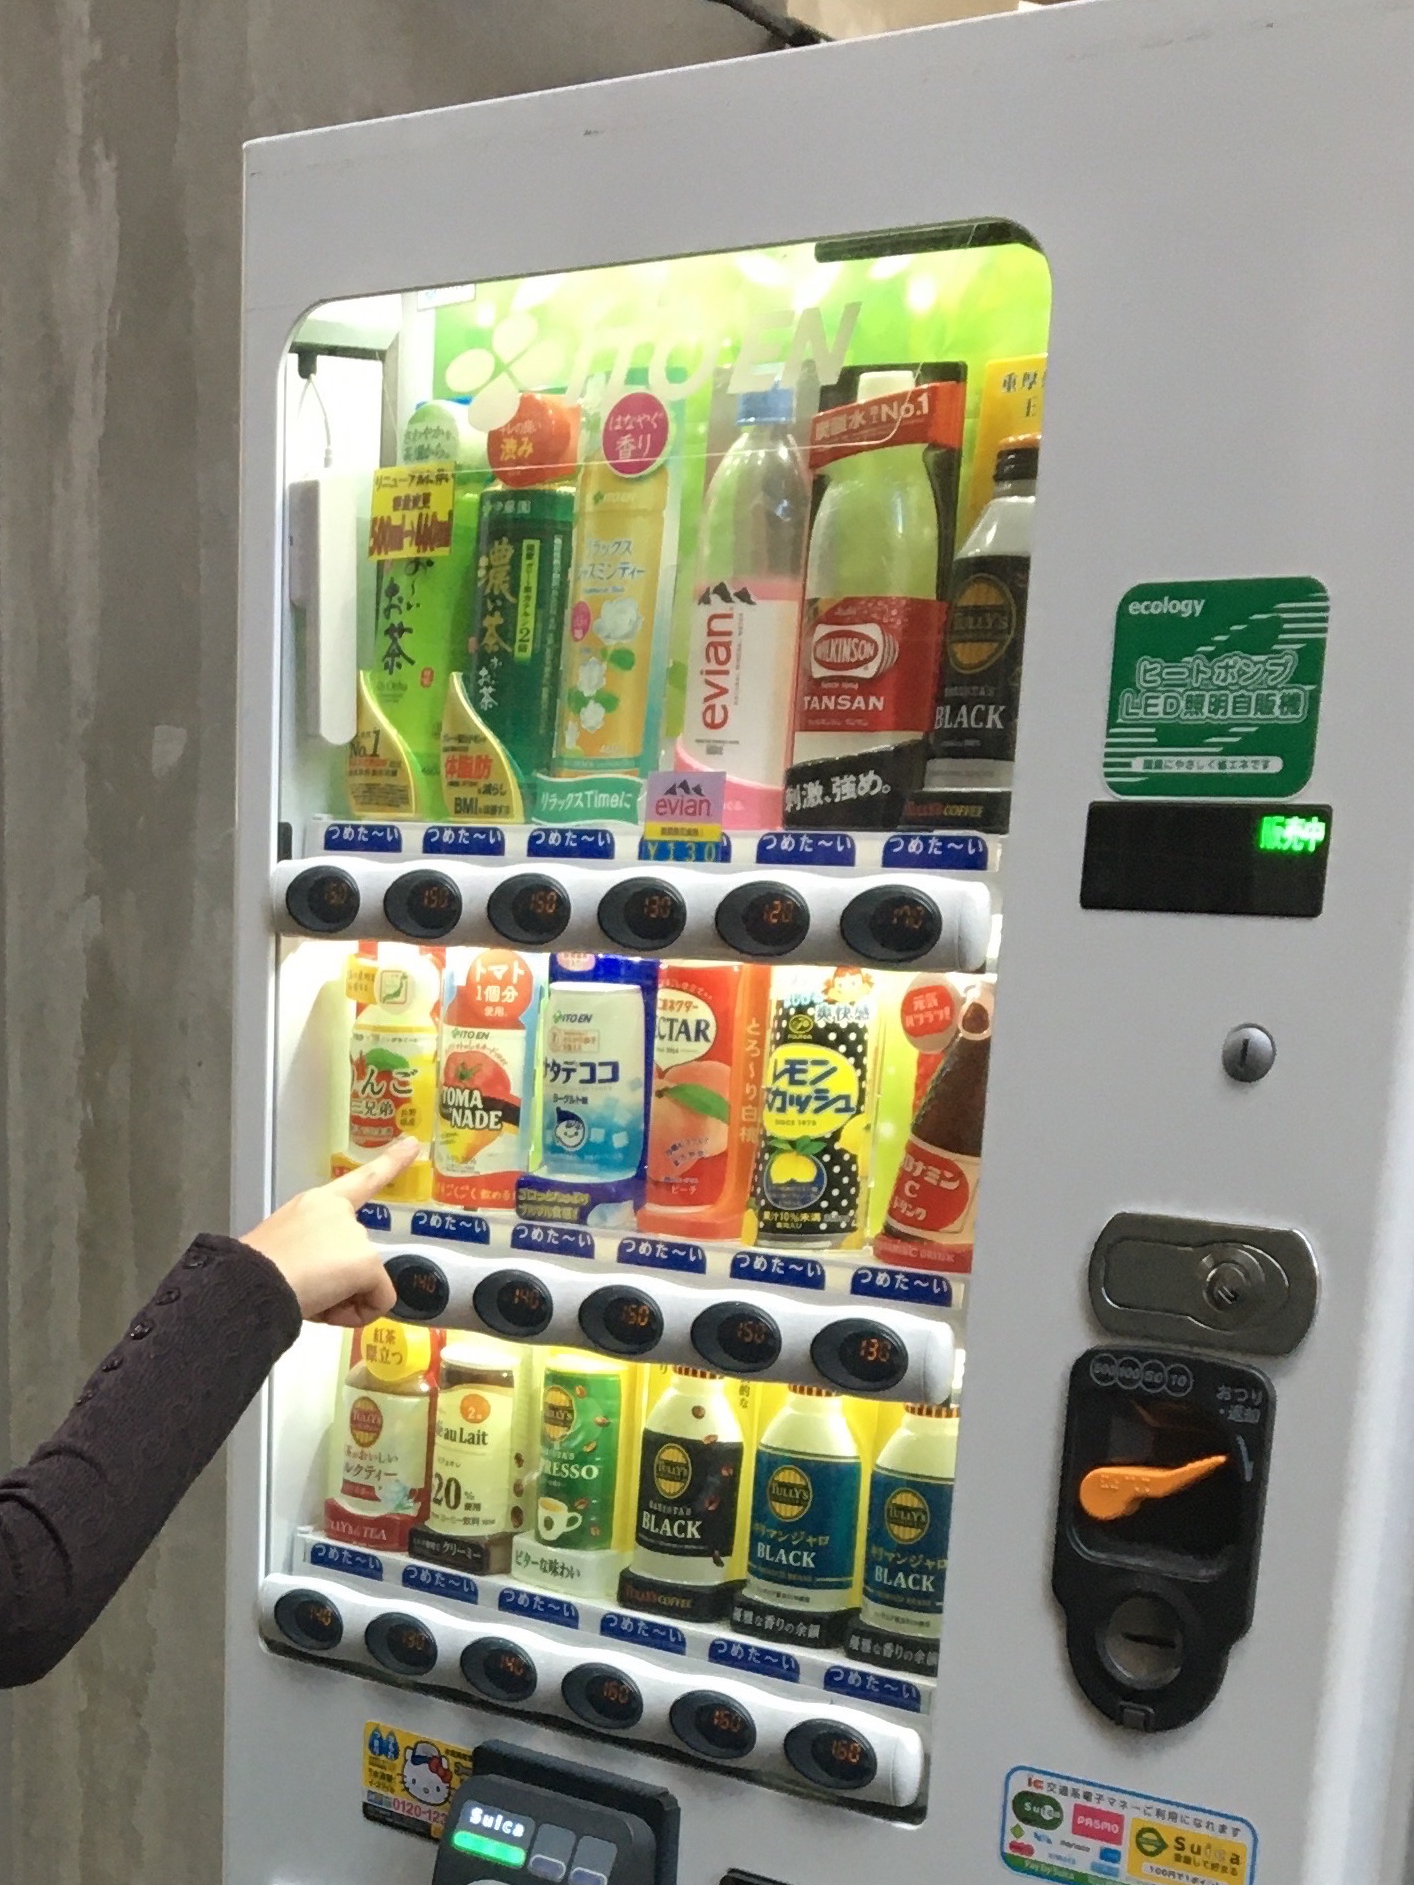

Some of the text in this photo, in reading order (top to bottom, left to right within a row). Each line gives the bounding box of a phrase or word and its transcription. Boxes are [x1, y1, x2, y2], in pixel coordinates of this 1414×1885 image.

[727, 301, 862, 394] EN
[609, 412, 665, 431] はなやぐ
[615, 434, 652, 460] 香り
[1128, 596, 1205, 617] ecology
[816, 638, 875, 662] WILKINSON
[702, 612, 734, 731] evian
[1139, 654, 1296, 688] ヒートポンプ
[803, 696, 885, 711] TANSAN
[1122, 690, 1305, 720] LED照明自販機
[935, 704, 1006, 729] BLACK
[785, 770, 891, 812] 刺激、強め。
[654, 796, 712, 817] evian
[327, 826, 399, 843] つめた〜い
[427, 828, 502, 845] つめた〜い
[532, 831, 611, 848] つめた〜い
[762, 834, 856, 855] つめた〜い
[889, 837, 984, 857] つめた〜い
[1259, 815, 1328, 854] 販売中
[475, 958, 525, 984] トマト
[475, 985, 519, 1004] 1個分
[771, 1058, 838, 1087] レモン
[442, 1086, 483, 1109] TOMA
[764, 1087, 857, 1115] スカッシュ
[903, 1179, 920, 1199] C
[414, 1211, 488, 1234] つめた〜い
[516, 1225, 592, 1247] つめた〜い
[622, 1238, 703, 1262] つめた〜い
[736, 1252, 822, 1277] つめた〜い
[857, 1266, 948, 1294] つめた〜い
[373, 1327, 397, 1345] 紅茶
[1217, 1385, 1264, 1406] おつり
[459, 1428, 490, 1446] Lait
[771, 1484, 810, 1501] TULLY'S
[642, 1510, 703, 1540] BLACK
[313, 1542, 382, 1570] つめた〜い
[515, 1549, 582, 1581] ビターな味わい
[757, 1542, 817, 1569] BLACK
[406, 1563, 476, 1593] つめた〜い
[875, 1565, 936, 1593] BLACK
[502, 1589, 577, 1619] つめた〜い
[603, 1611, 685, 1644] つめた〜い
[713, 1638, 798, 1672] つめた〜い
[829, 1665, 919, 1700] つめた〜い
[469, 1806, 525, 1838] Suica
[1077, 1815, 1119, 1834] PASMO
[1174, 1835, 1241, 1866] Suica
